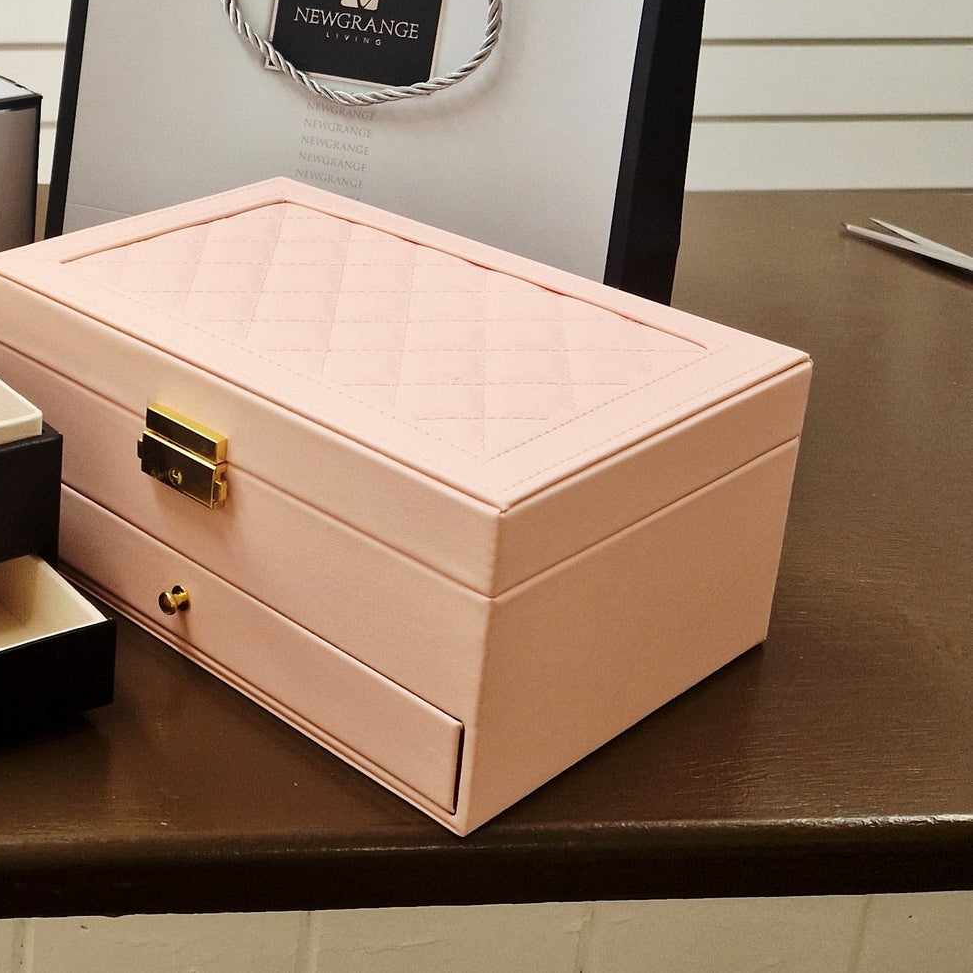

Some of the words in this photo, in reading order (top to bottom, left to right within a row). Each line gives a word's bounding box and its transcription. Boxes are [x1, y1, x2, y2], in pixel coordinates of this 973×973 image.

[293, 6, 420, 39] NEWGRANGE
[326, 31, 382, 46] LIVING
[307, 102, 376, 121] NEWGRANGE
[304, 118, 372, 138] NEWGRANGE
[301, 135, 369, 155] NEWGRANGE
[298, 152, 367, 172] NEWGRANGE
[296, 169, 364, 189] NEWGRANGE
